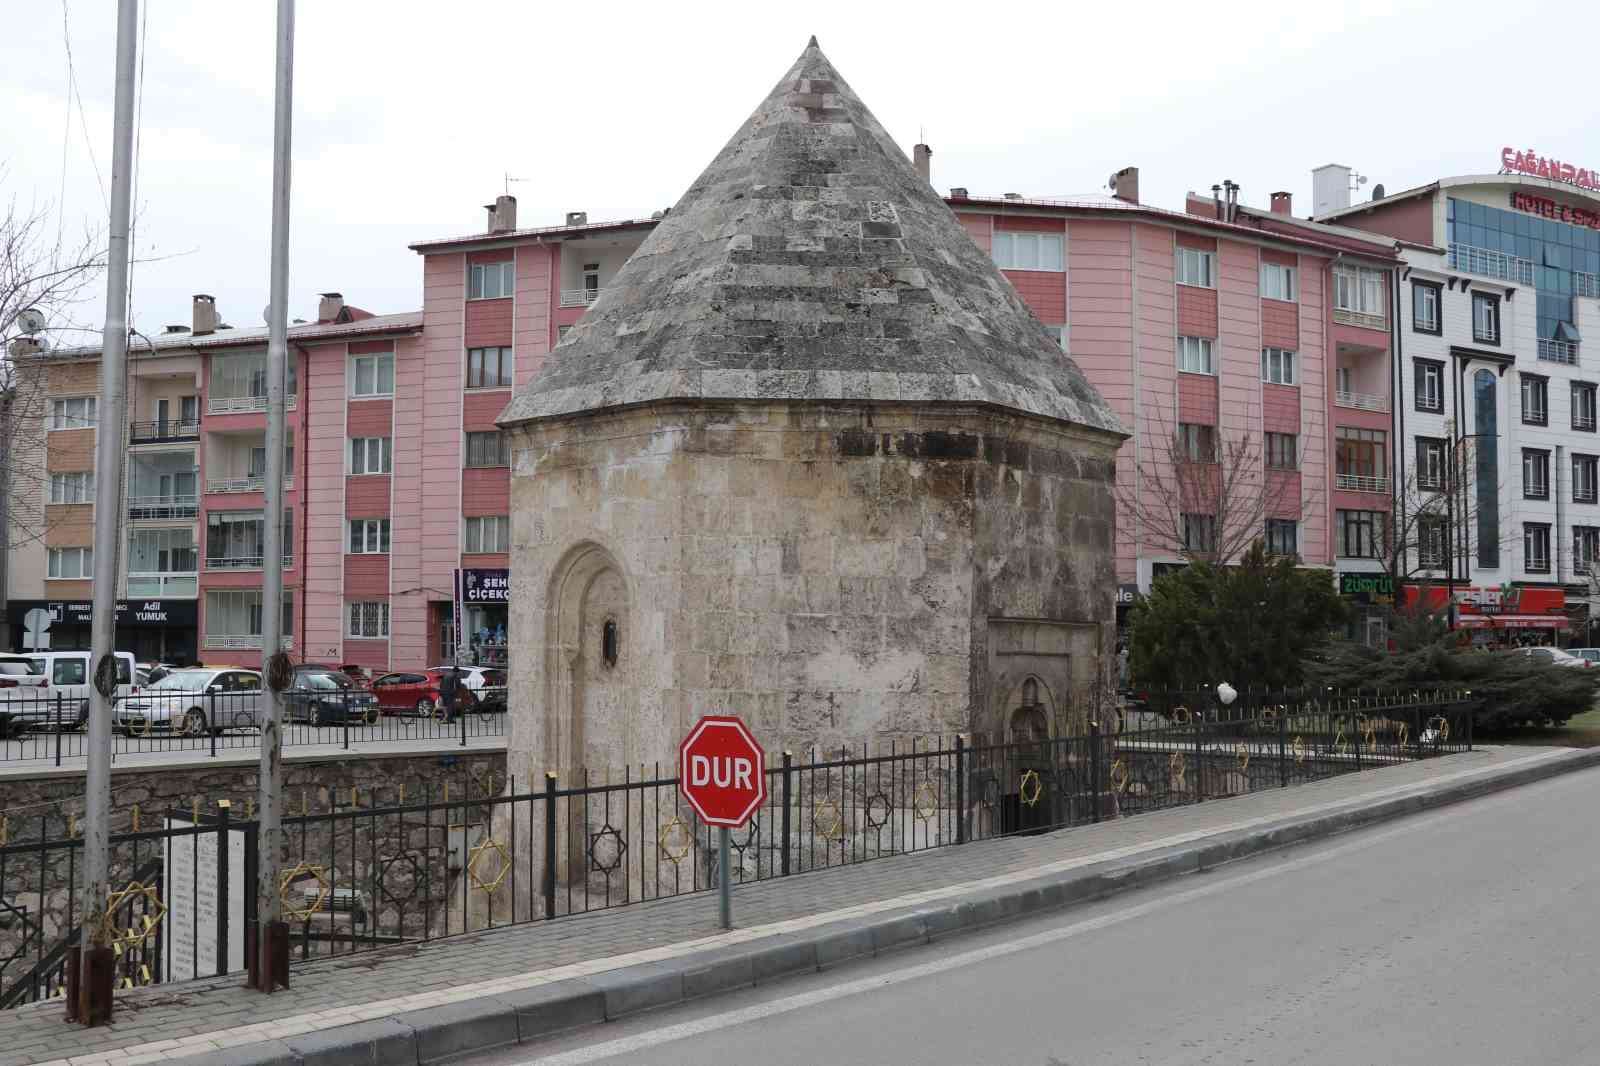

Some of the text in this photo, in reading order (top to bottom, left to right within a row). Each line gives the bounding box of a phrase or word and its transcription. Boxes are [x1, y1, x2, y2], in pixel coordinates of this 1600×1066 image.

[143, 602, 161, 611] Adil
[135, 612, 167, 621] YUMUK
[691, 755, 753, 790] DUR
